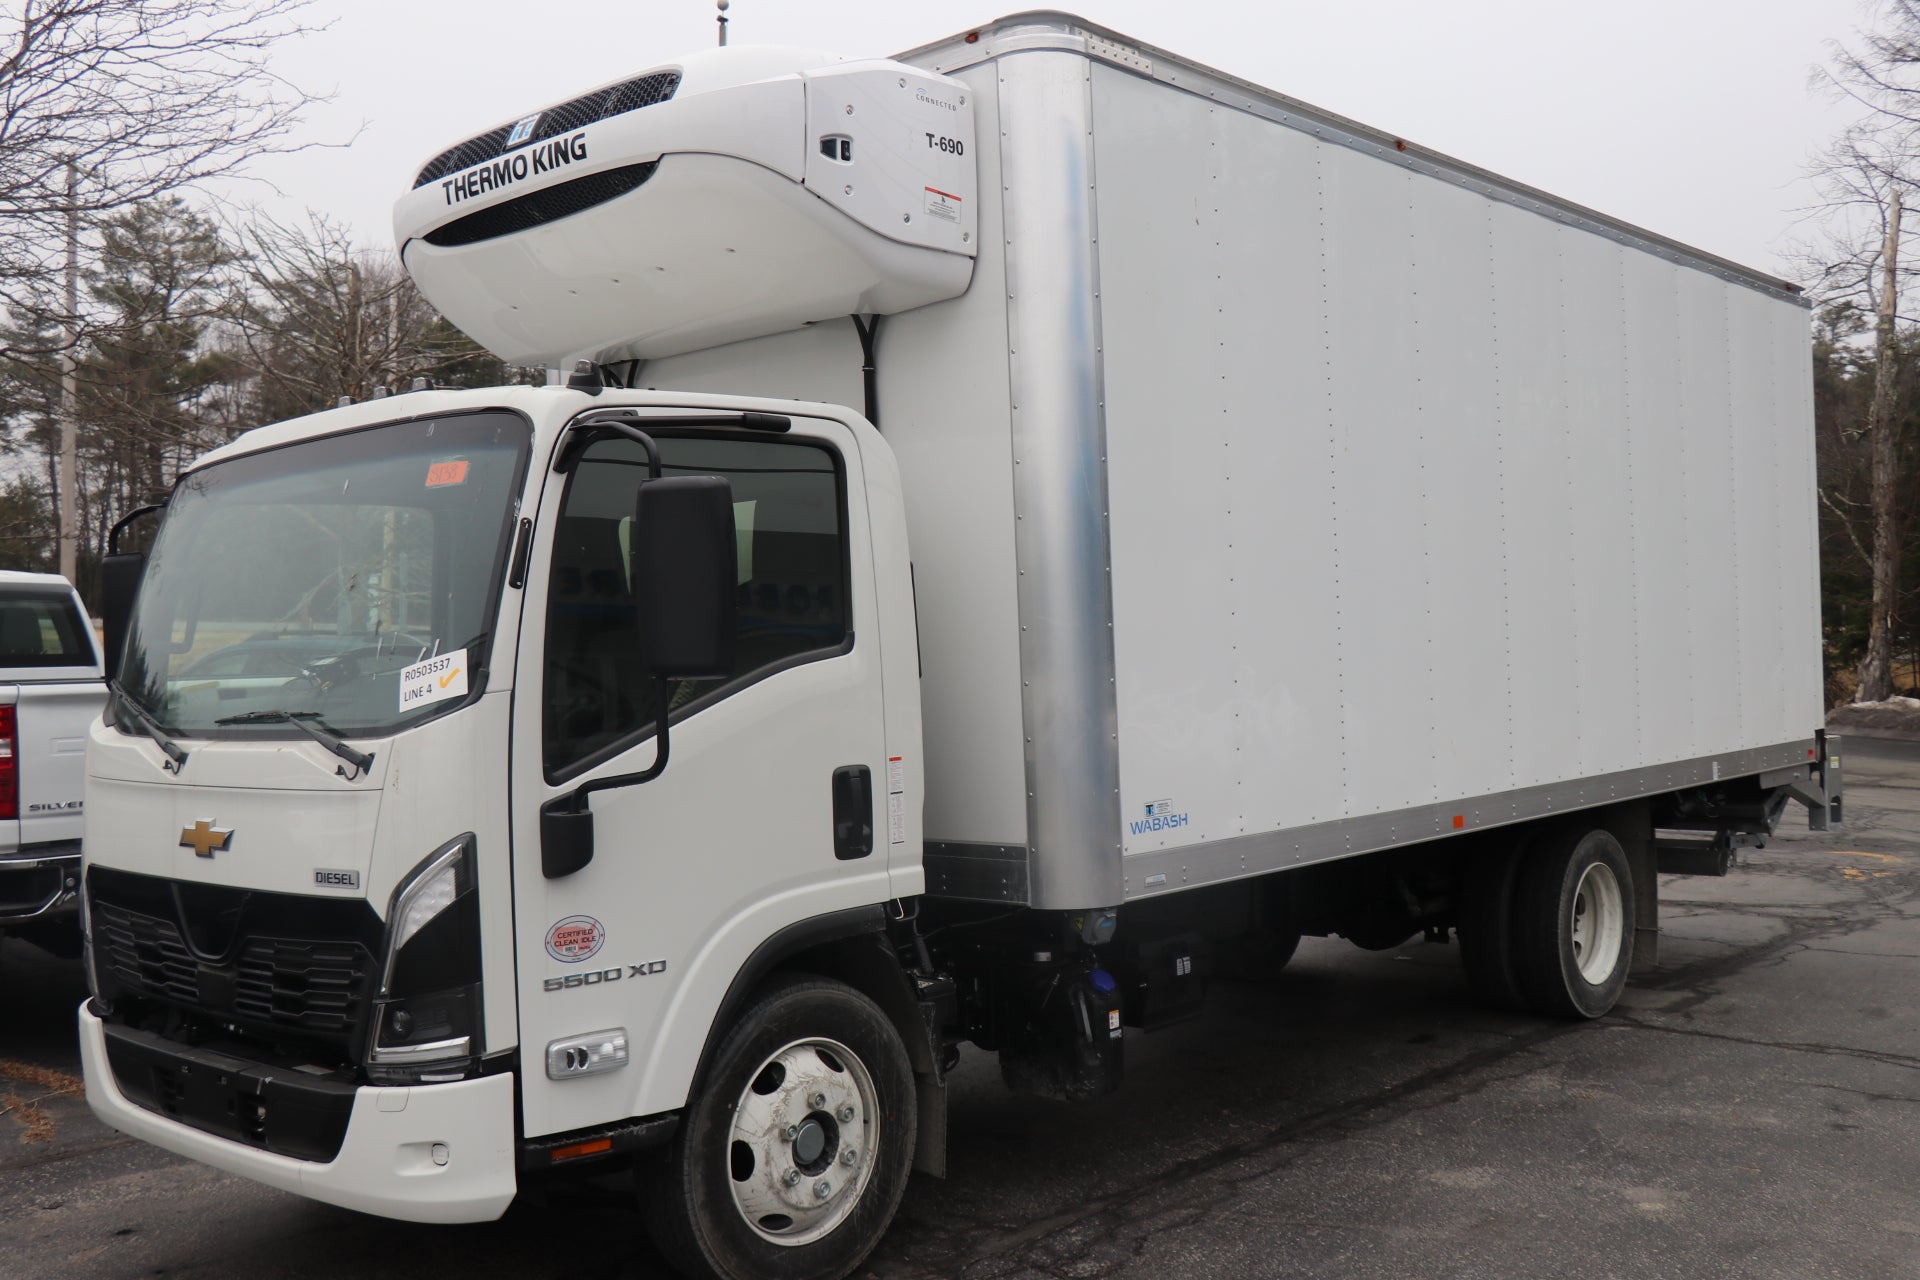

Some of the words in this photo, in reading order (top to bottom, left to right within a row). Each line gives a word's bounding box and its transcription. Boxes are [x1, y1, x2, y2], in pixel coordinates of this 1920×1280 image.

[916, 93, 957, 111] CONNECTED
[925, 132, 964, 156] T-690
[442, 154, 528, 205] THERMO
[533, 132, 588, 175] KING
[405, 658, 450, 682] R0503537
[404, 686, 424, 702] LINE
[426, 684, 433, 694] 4
[1130, 812, 1188, 835] WABASH
[315, 871, 355, 886] DIESEL
[554, 939, 578, 947] CLEAN
[557, 929, 594, 939] CERTIFIED
[544, 967, 622, 992] 5500
[626, 959, 667, 979] XD
